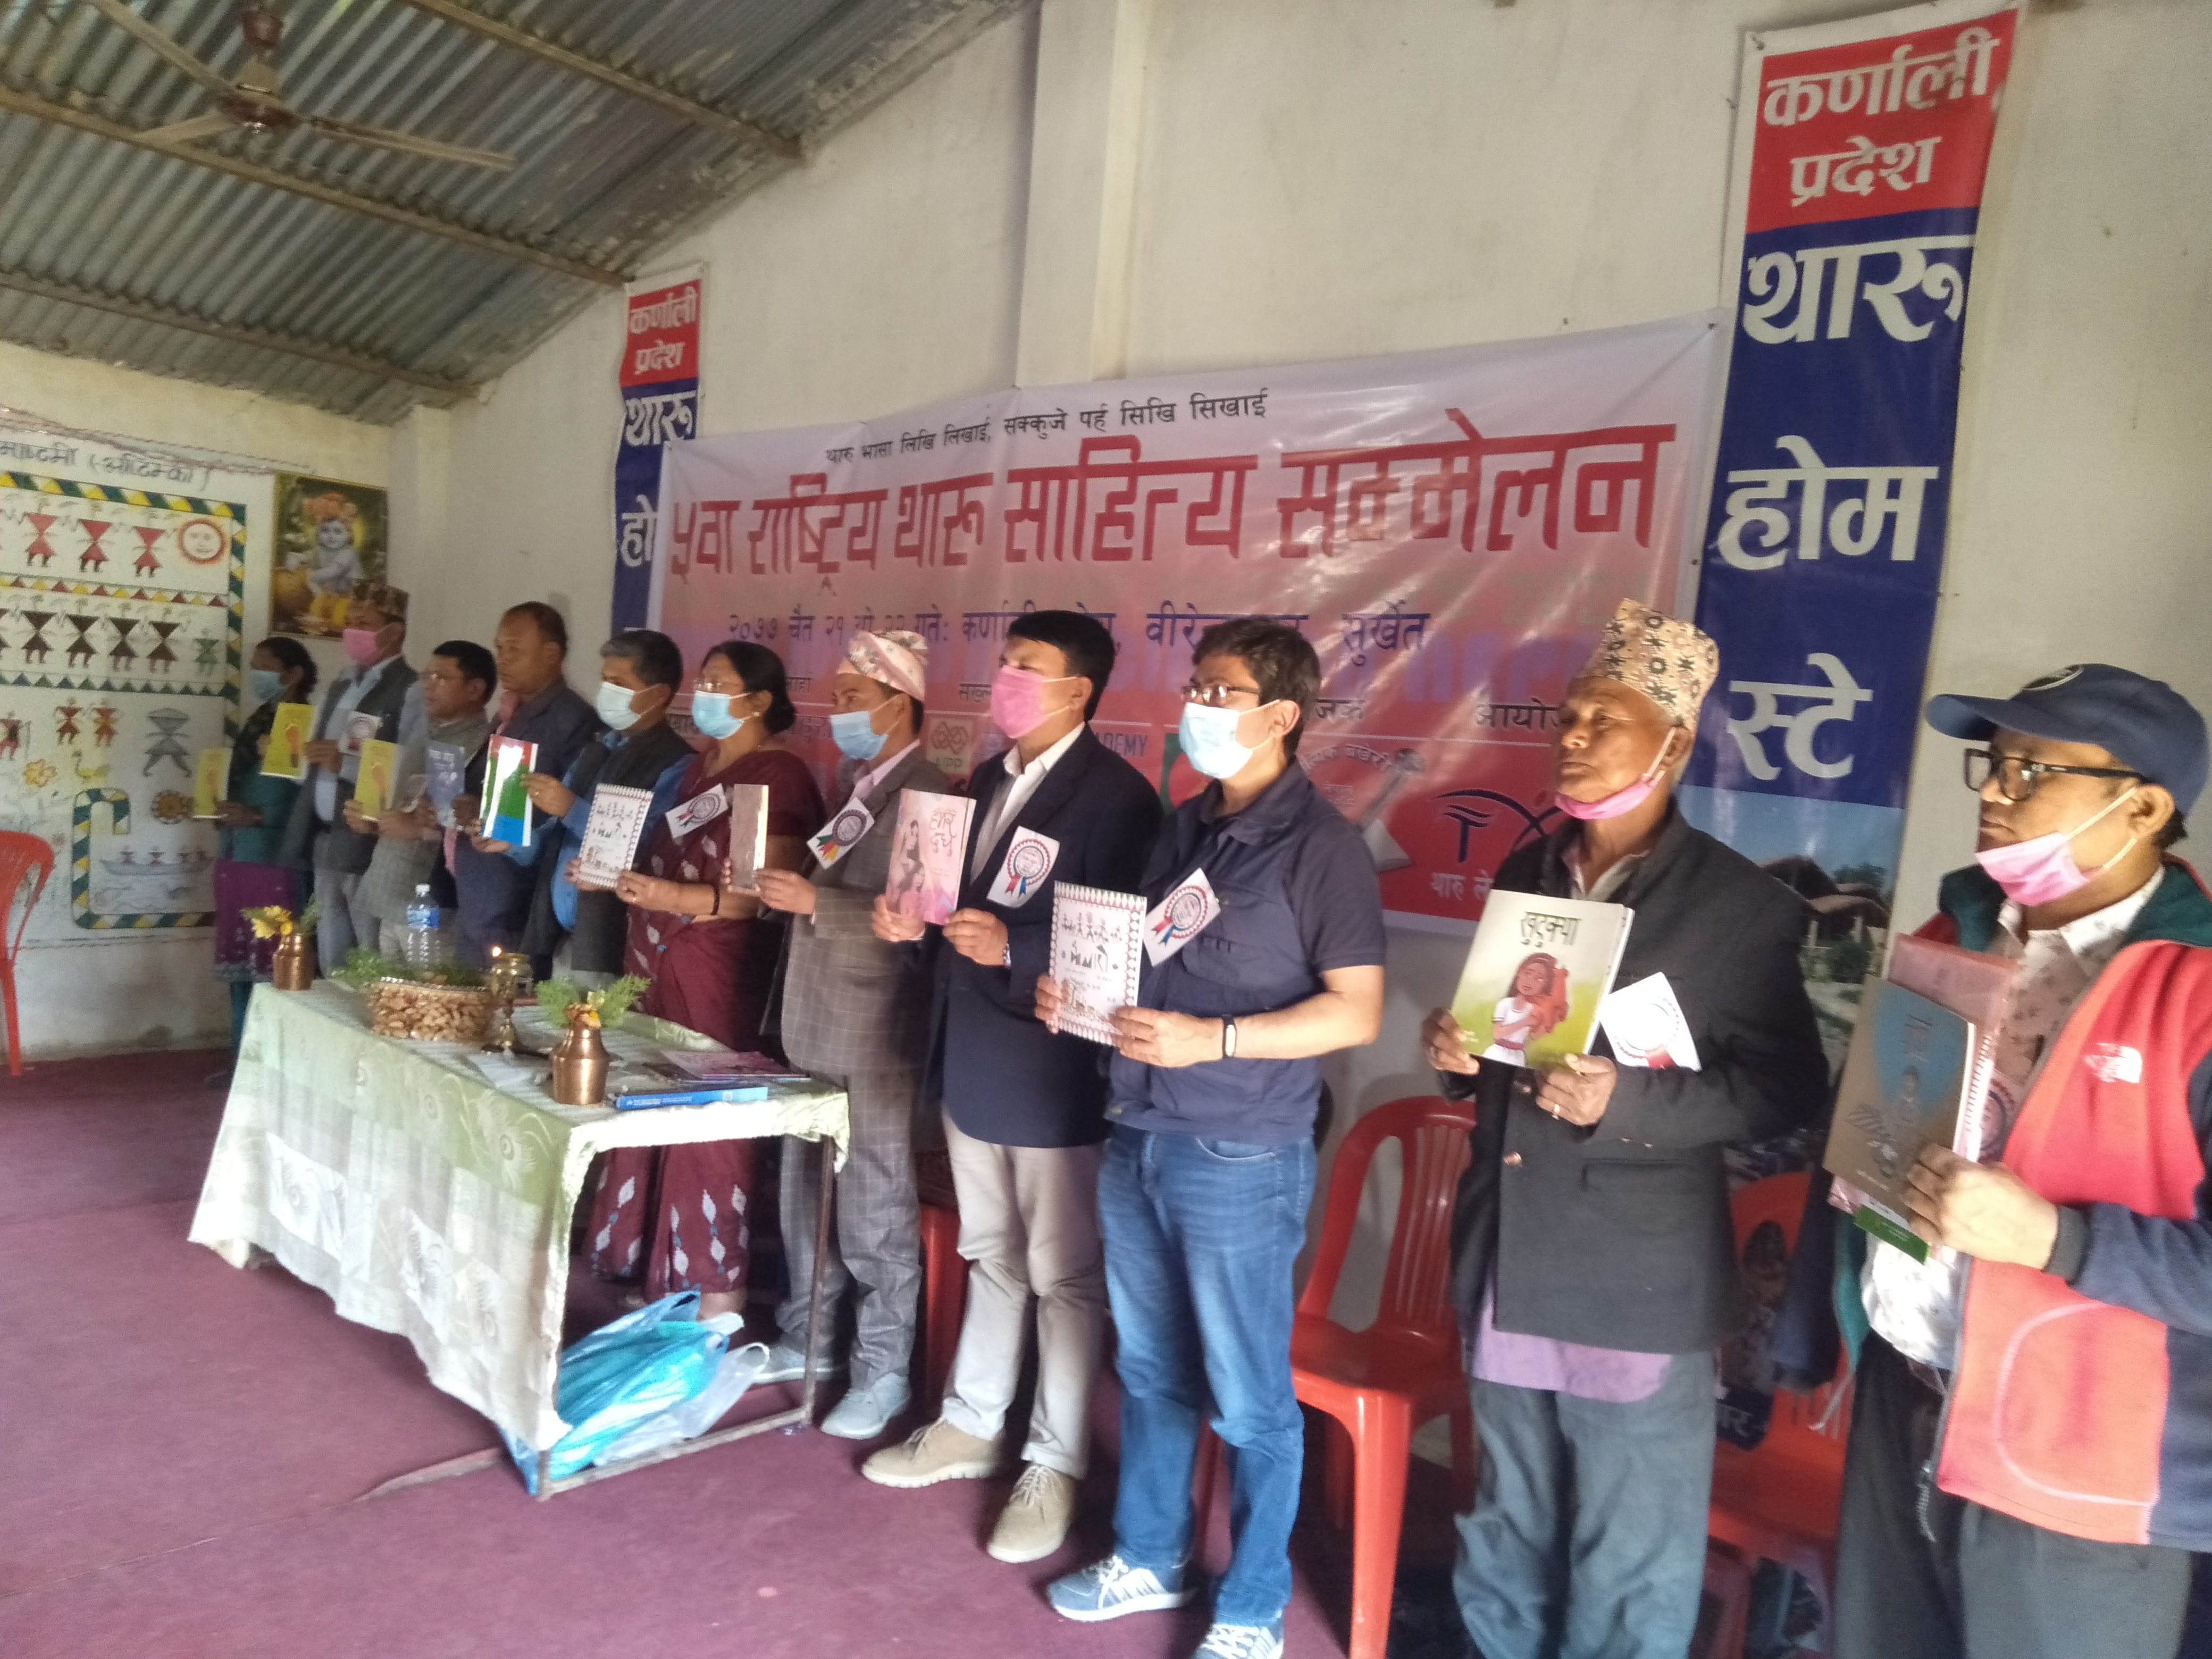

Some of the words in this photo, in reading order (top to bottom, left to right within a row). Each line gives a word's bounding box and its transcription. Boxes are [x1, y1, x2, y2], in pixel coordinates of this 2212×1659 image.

[1764, 27, 2001, 127] कर्णाली
[1790, 136, 1941, 206] प्रदेश
[630, 287, 697, 334] कर्णाली
[1742, 234, 1975, 343] थारू
[634, 340, 685, 375] प्रदेश
[625, 391, 696, 446] थारू
[900, 429, 936, 454] लिखि
[1004, 408, 1067, 439] सक्कुजे
[1120, 397, 1177, 426] सिखि
[1190, 388, 1268, 420] सिखाई
[621, 495, 657, 567] हो
[748, 472, 889, 596] राष्ट्रिय
[894, 472, 993, 567] थारू
[1004, 434, 1258, 563] साहित्य
[1277, 407, 1676, 558] सम्मेलन
[1717, 435, 1938, 570] होम
[789, 602, 816, 642] चैत
[1343, 599, 1430, 666] सुर्खेत
[1727, 652, 1873, 780] स्टे
